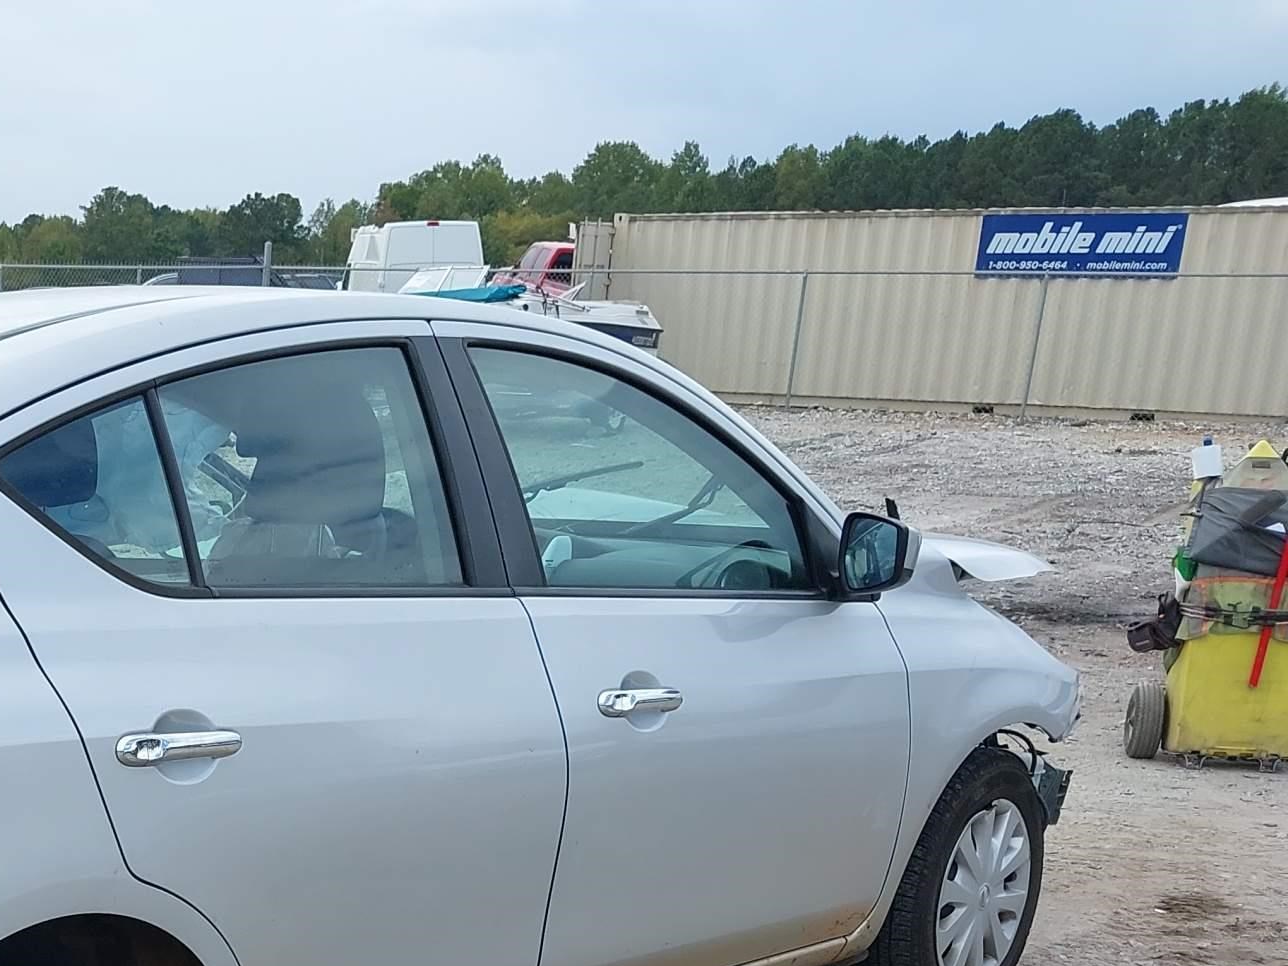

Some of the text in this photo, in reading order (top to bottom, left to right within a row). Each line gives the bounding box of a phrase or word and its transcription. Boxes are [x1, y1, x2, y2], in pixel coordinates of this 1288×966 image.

[985, 221, 1178, 254] mobile mini
[988, 260, 1168, 270] 1-800-950-6464 mobilemini.com
